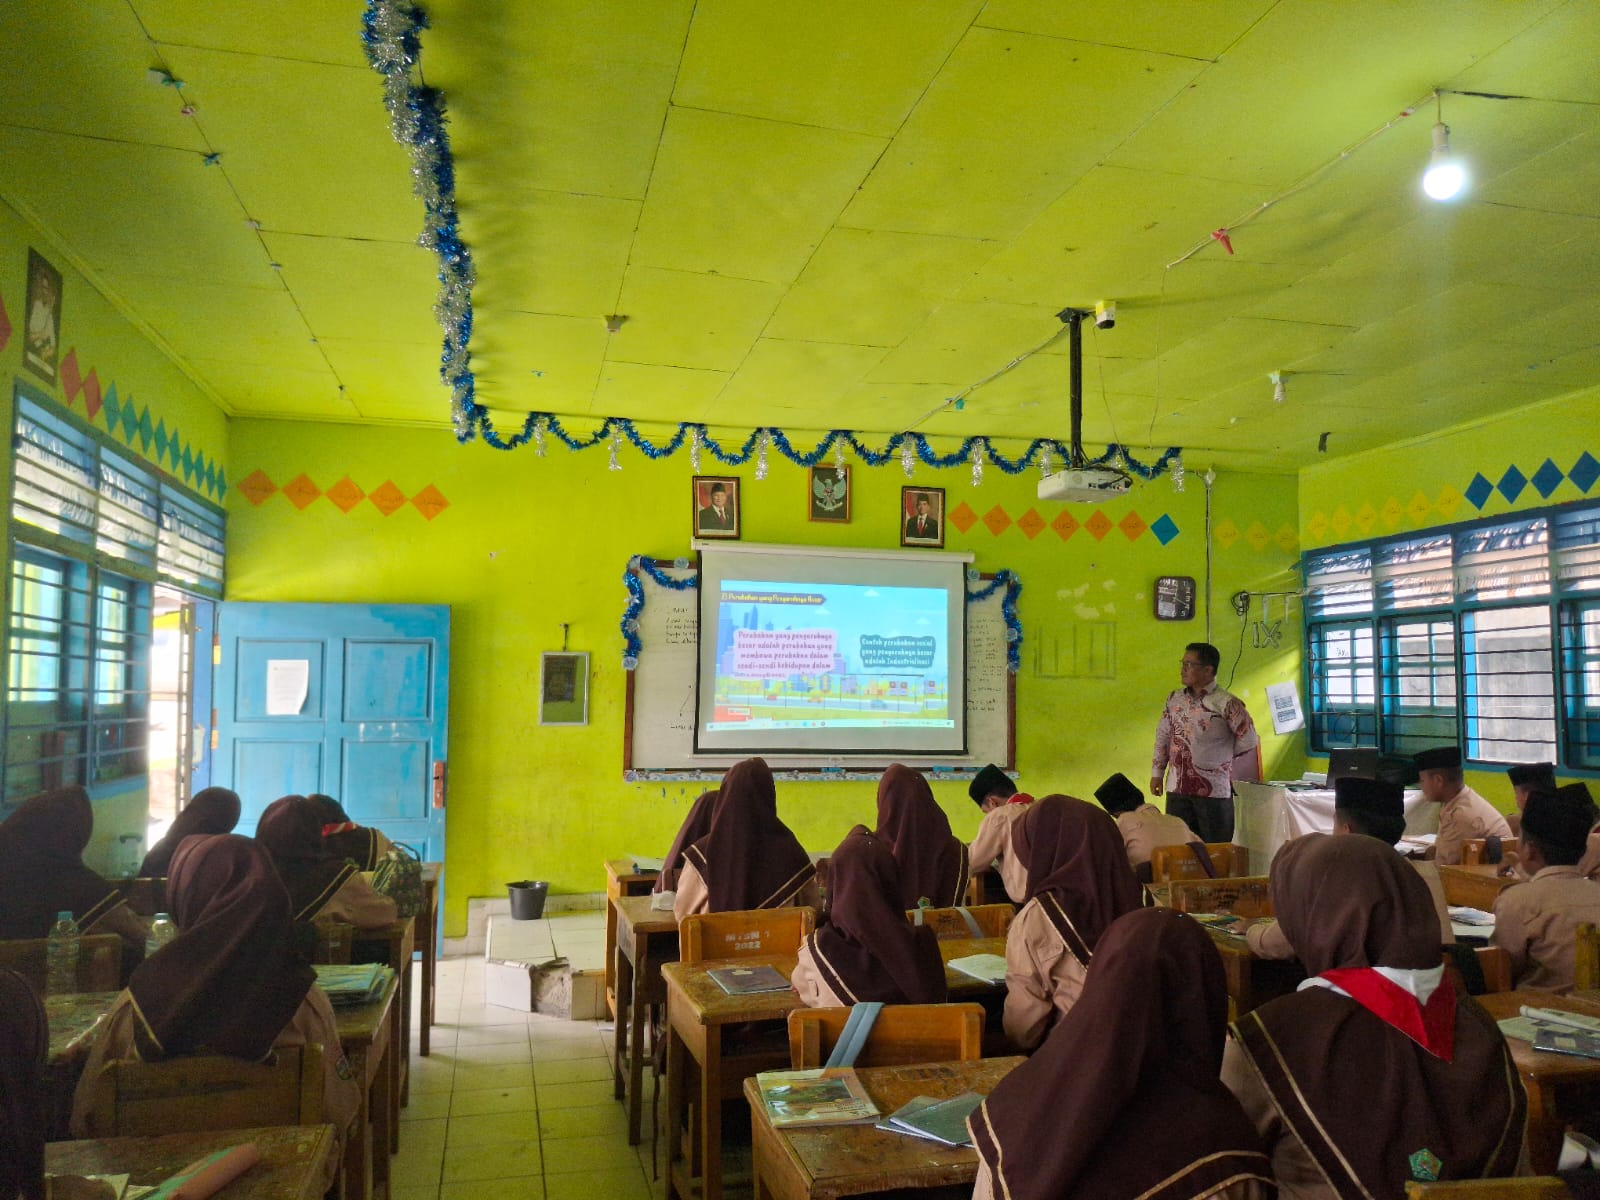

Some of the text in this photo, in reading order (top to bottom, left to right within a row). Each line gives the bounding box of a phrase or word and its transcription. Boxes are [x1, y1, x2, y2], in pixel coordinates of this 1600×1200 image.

[738, 631, 773, 639] Perubahan
[775, 633, 791, 641] yang
[758, 641, 780, 649] adalah
[781, 642, 815, 651] perubahan
[740, 650, 829, 661] membawa perubahan dalam
[811, 661, 831, 669] dalam
[734, 940, 761, 951] 2022
